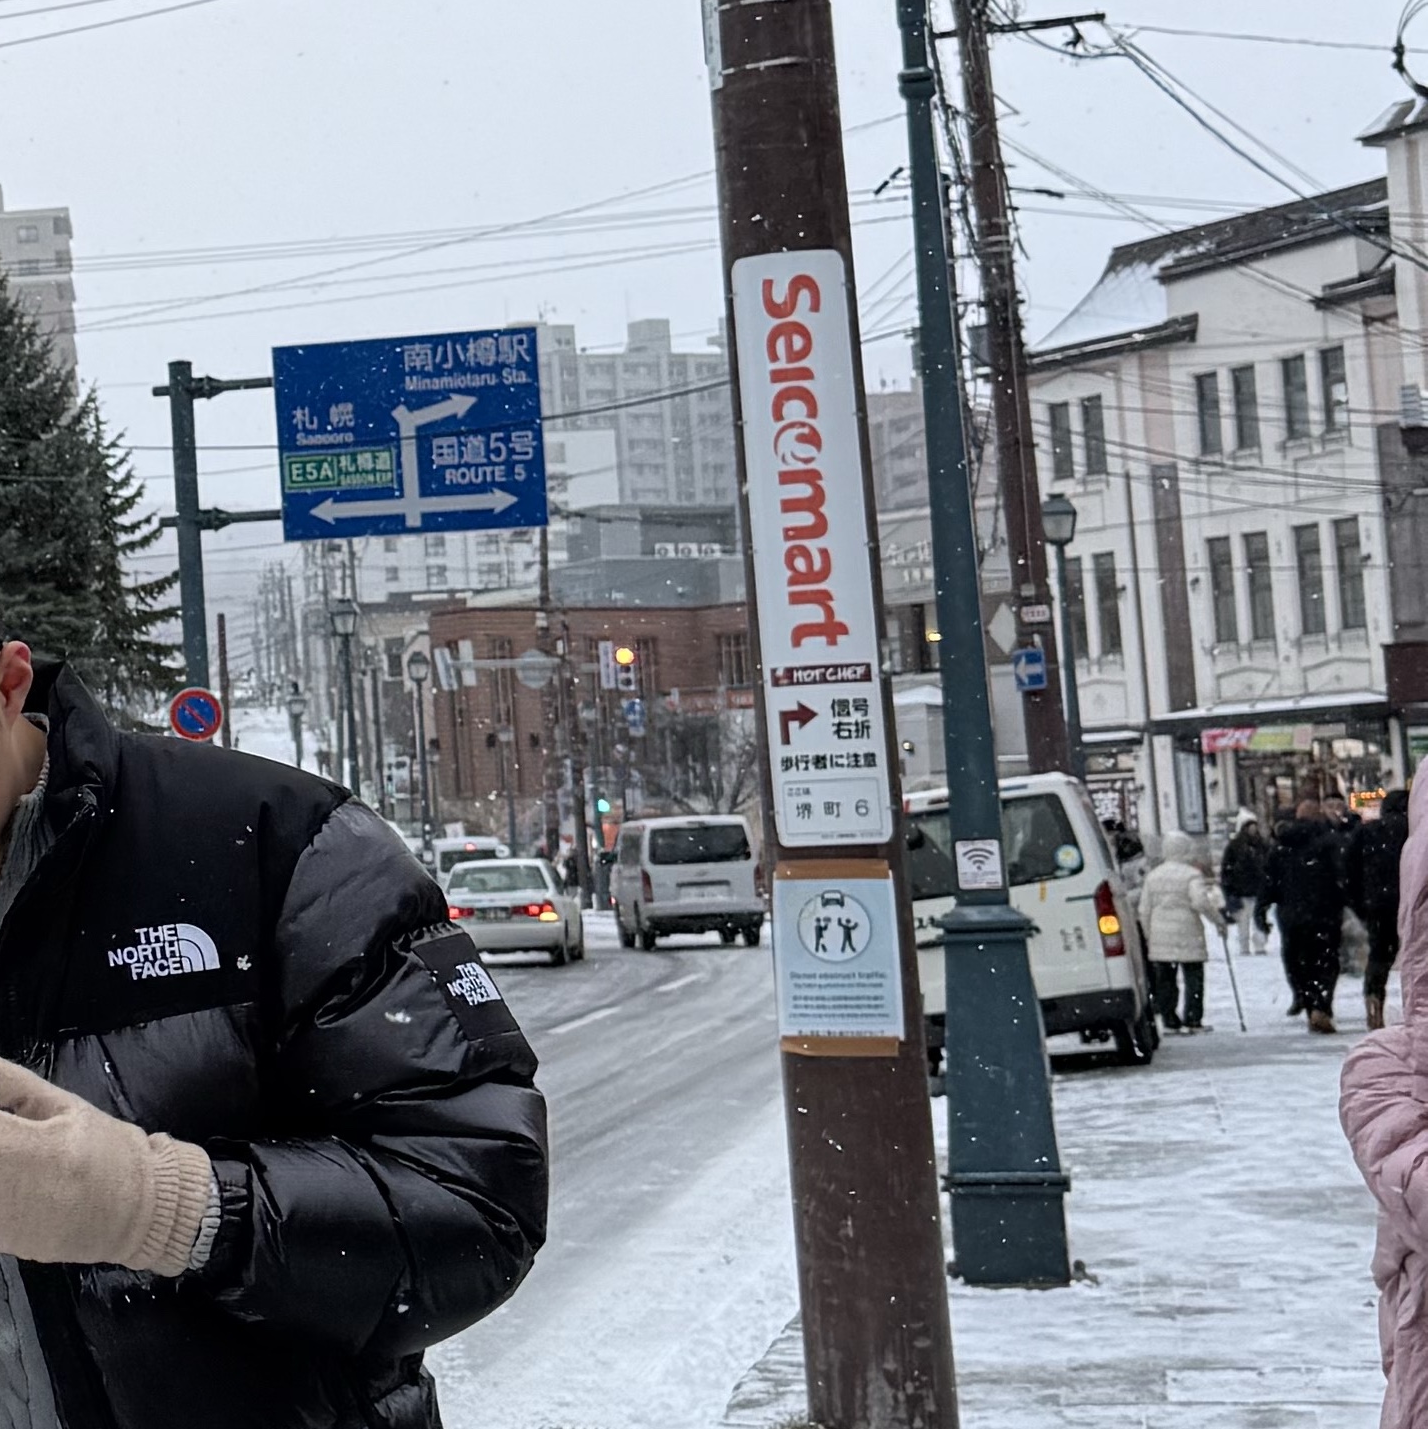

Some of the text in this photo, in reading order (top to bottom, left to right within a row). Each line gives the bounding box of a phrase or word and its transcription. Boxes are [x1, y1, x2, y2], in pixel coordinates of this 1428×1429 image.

[403, 334, 531, 373] 南小樽駅
[405, 374, 496, 391] Minamiotaru
[293, 402, 355, 430] 札幌
[431, 430, 537, 466] 国道5号
[291, 461, 334, 483] E5A
[761, 273, 850, 649] Seicomart
[445, 464, 527, 486] ROUTE 5
[793, 665, 867, 684] HOT CHEF
[831, 698, 870, 719] 信号
[832, 720, 871, 740] 右折
[780, 752, 878, 772] 歩行者に注意
[135, 924, 178, 944] THE
[107, 940, 180, 967] NORTH
[130, 957, 183, 980] FACE
[447, 976, 485, 997] NORTH
